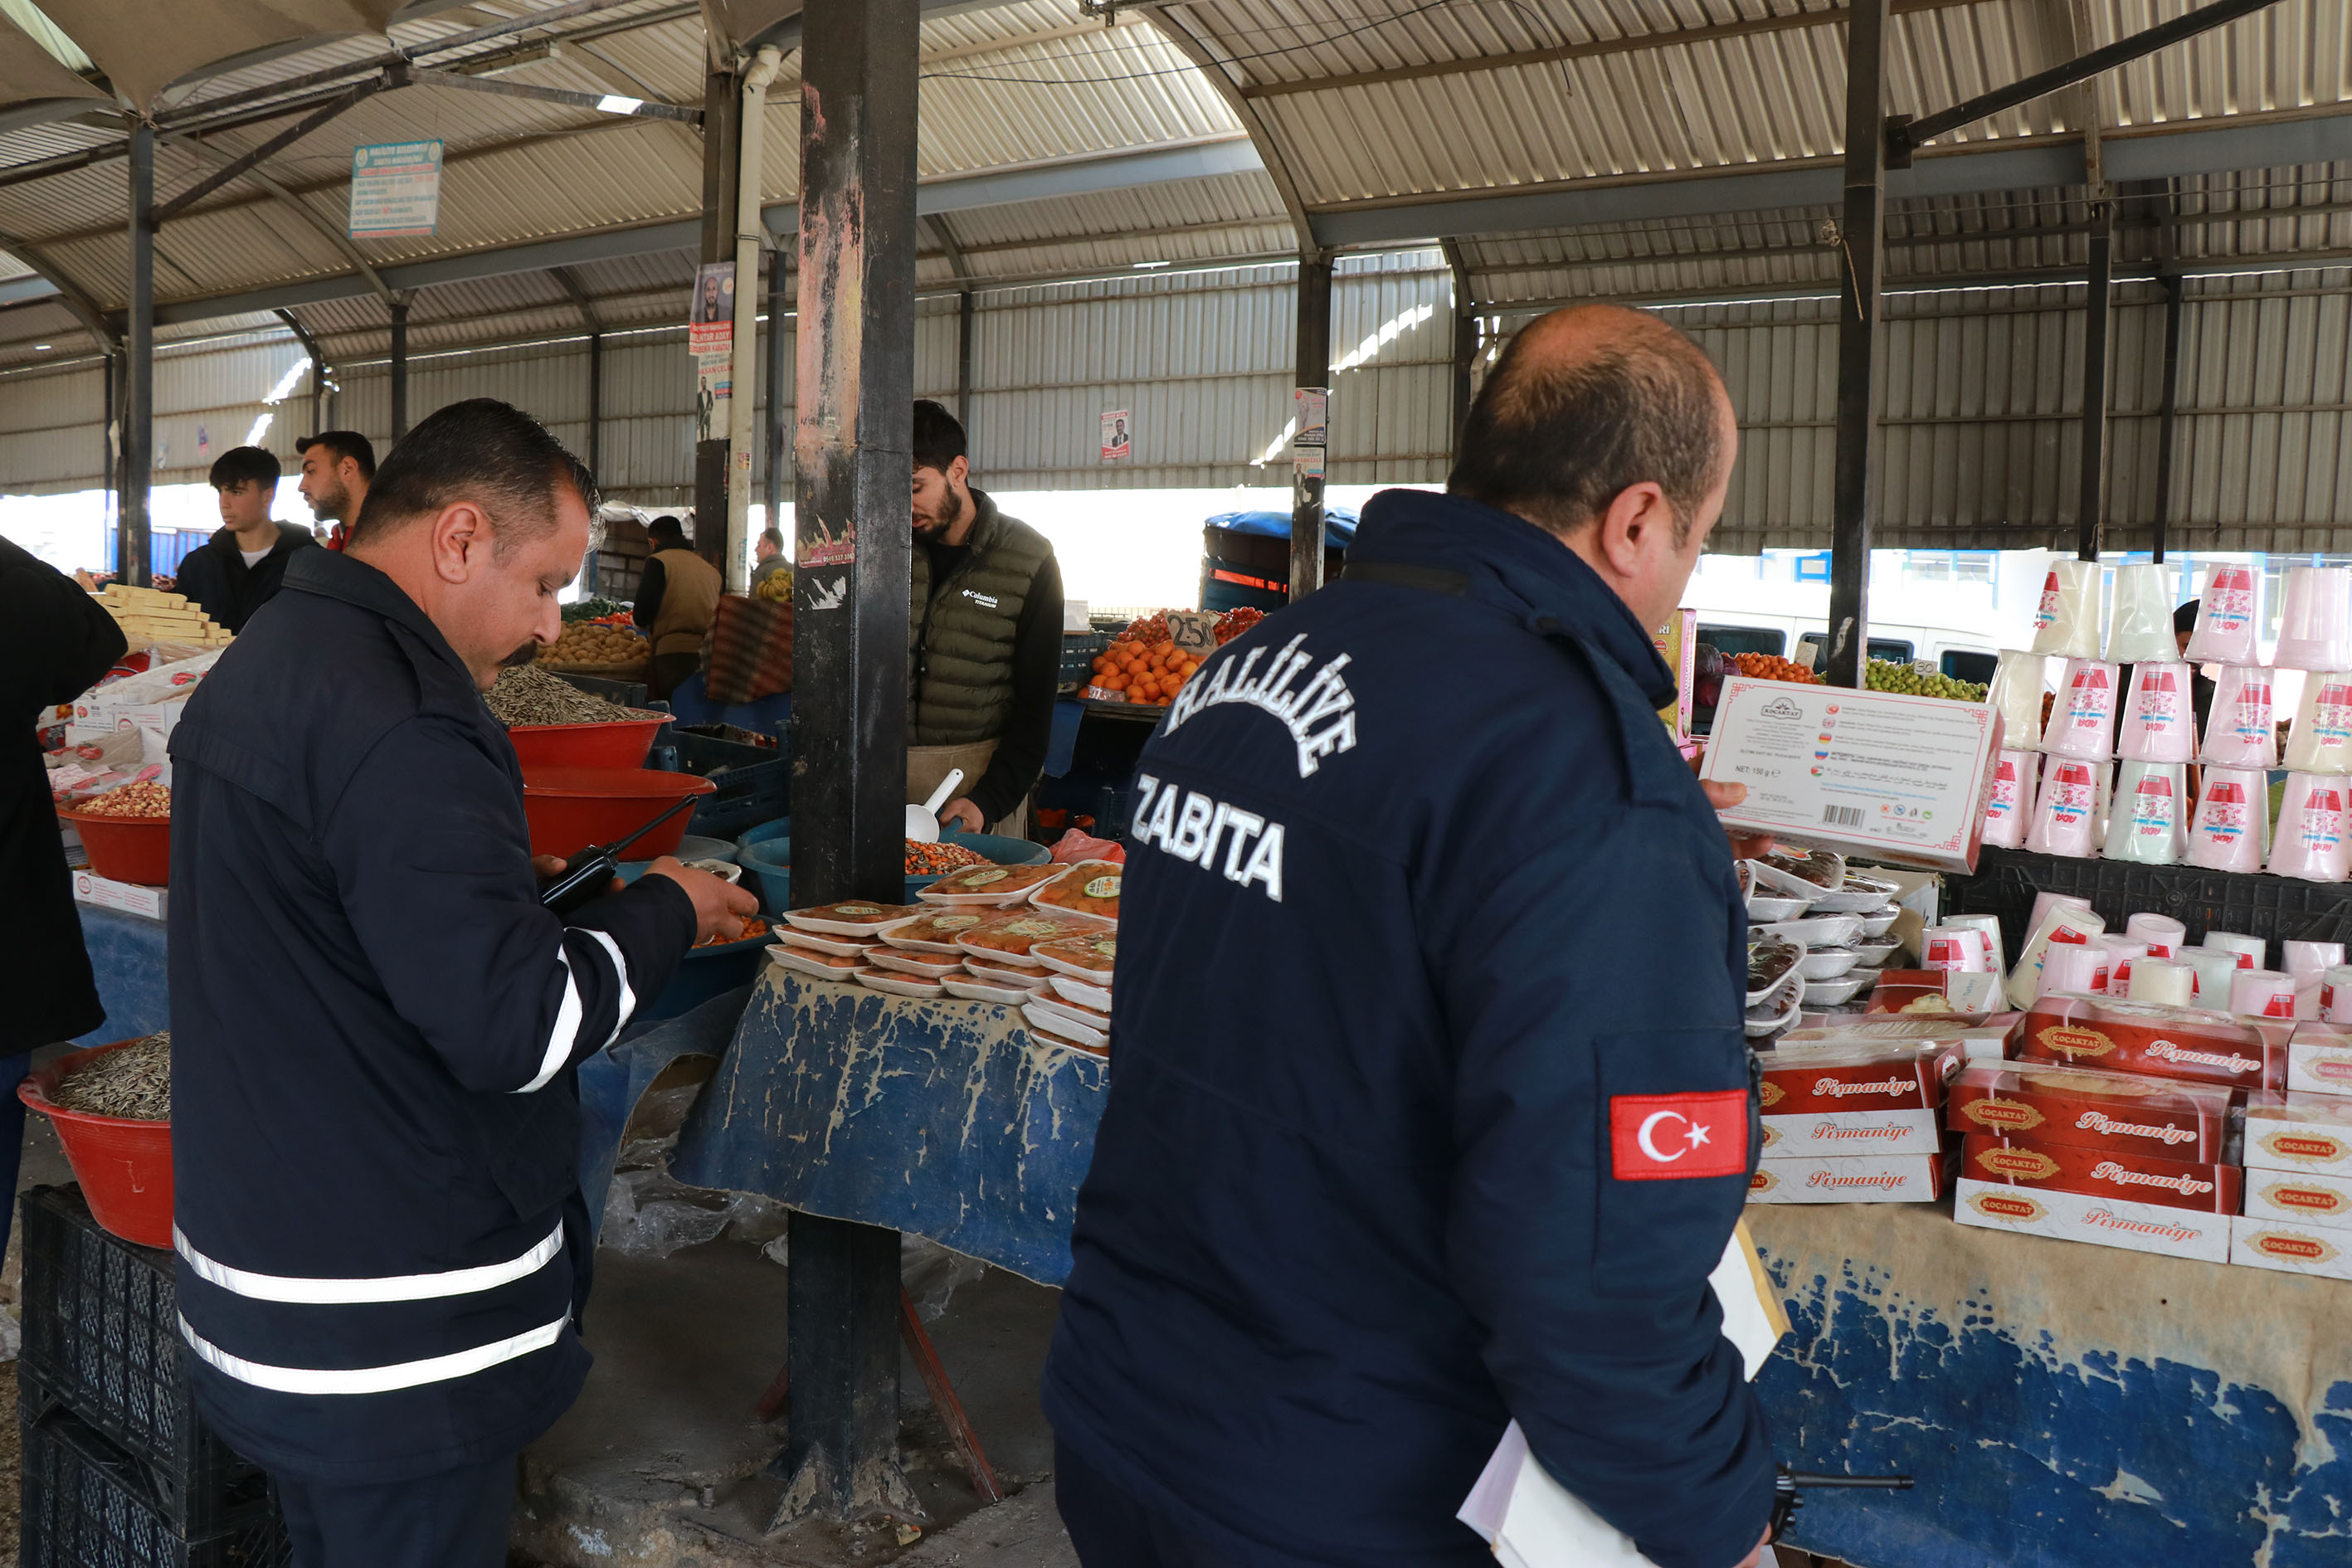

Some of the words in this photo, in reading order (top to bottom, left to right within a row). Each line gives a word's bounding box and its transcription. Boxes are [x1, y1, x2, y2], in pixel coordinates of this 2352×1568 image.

[969, 591, 998, 604] Columbia
[975, 599, 997, 609] TITANIUM
[1916, 661, 1935, 674] 30
[1160, 633, 1357, 778] HALİLİYE
[2078, 719, 2098, 728] ADA
[2056, 814, 2077, 823] ADA
[1131, 772, 1286, 903] ZABITA
[2141, 826, 2162, 835] ADA
[2213, 835, 2234, 844] ADA
[2052, 1035, 2100, 1047] KOÇAKTAT
[2145, 1040, 2261, 1074] Pişmaniye
[1812, 1076, 1916, 1098] Pişmaniye
[1811, 1122, 1914, 1141] Pişmaniye
[1978, 1108, 2029, 1121] KOÇAKTAT
[2075, 1112, 2197, 1145] Pişmaniye
[2276, 1141, 2334, 1154] KOÇAKTAT
[1806, 1170, 1907, 1191] Pişmaniye
[2091, 1161, 2213, 1195] Pişmaniye
[2277, 1193, 2335, 1206] KOÇAKTAT
[1983, 1200, 2032, 1213] KOÇAKTAT
[2081, 1208, 2202, 1242] Pişmaniye
[2262, 1239, 2320, 1254] KOÇAKTAT
